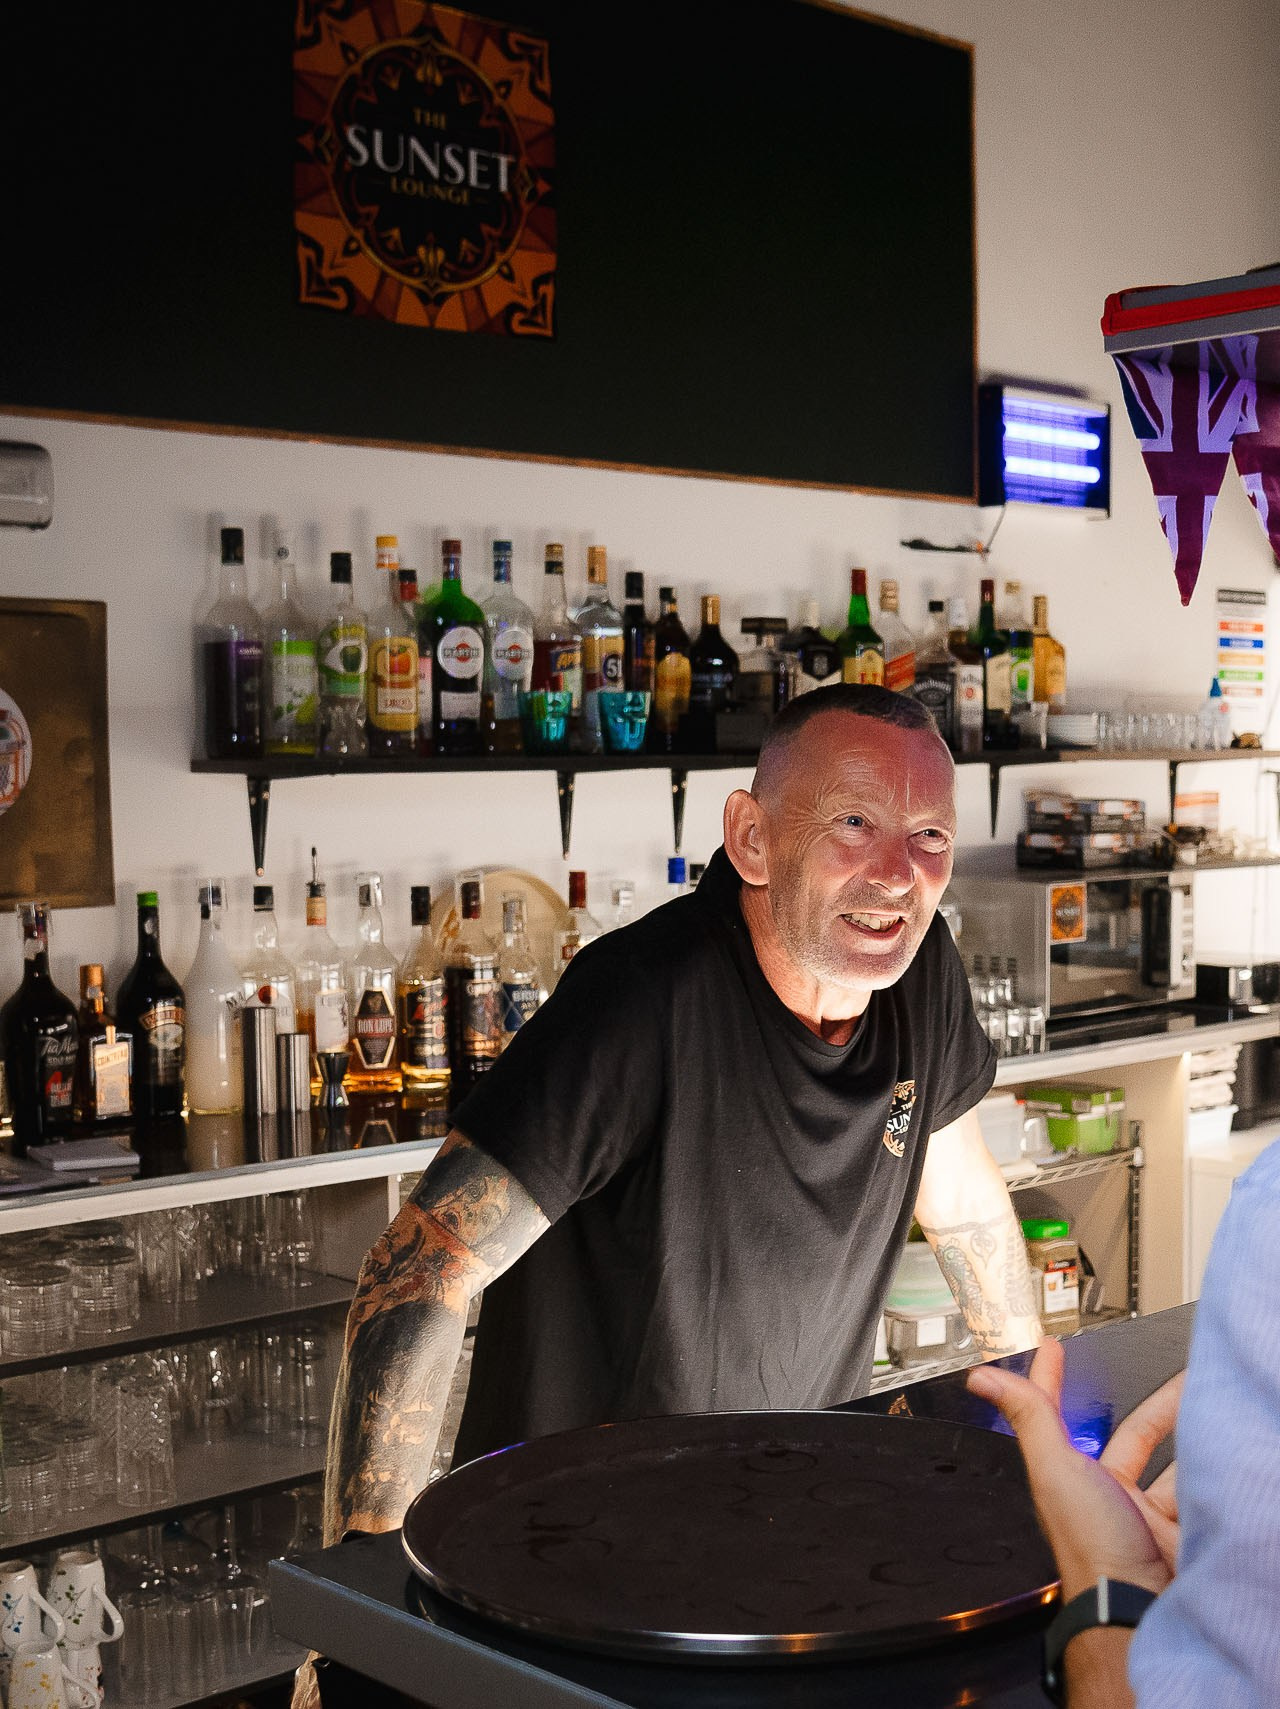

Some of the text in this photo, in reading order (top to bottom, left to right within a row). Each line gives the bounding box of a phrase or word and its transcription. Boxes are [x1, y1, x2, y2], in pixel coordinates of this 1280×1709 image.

[412, 106, 447, 130] THE
[346, 124, 516, 193] SUNSET
[390, 175, 470, 206] LOUNGE
